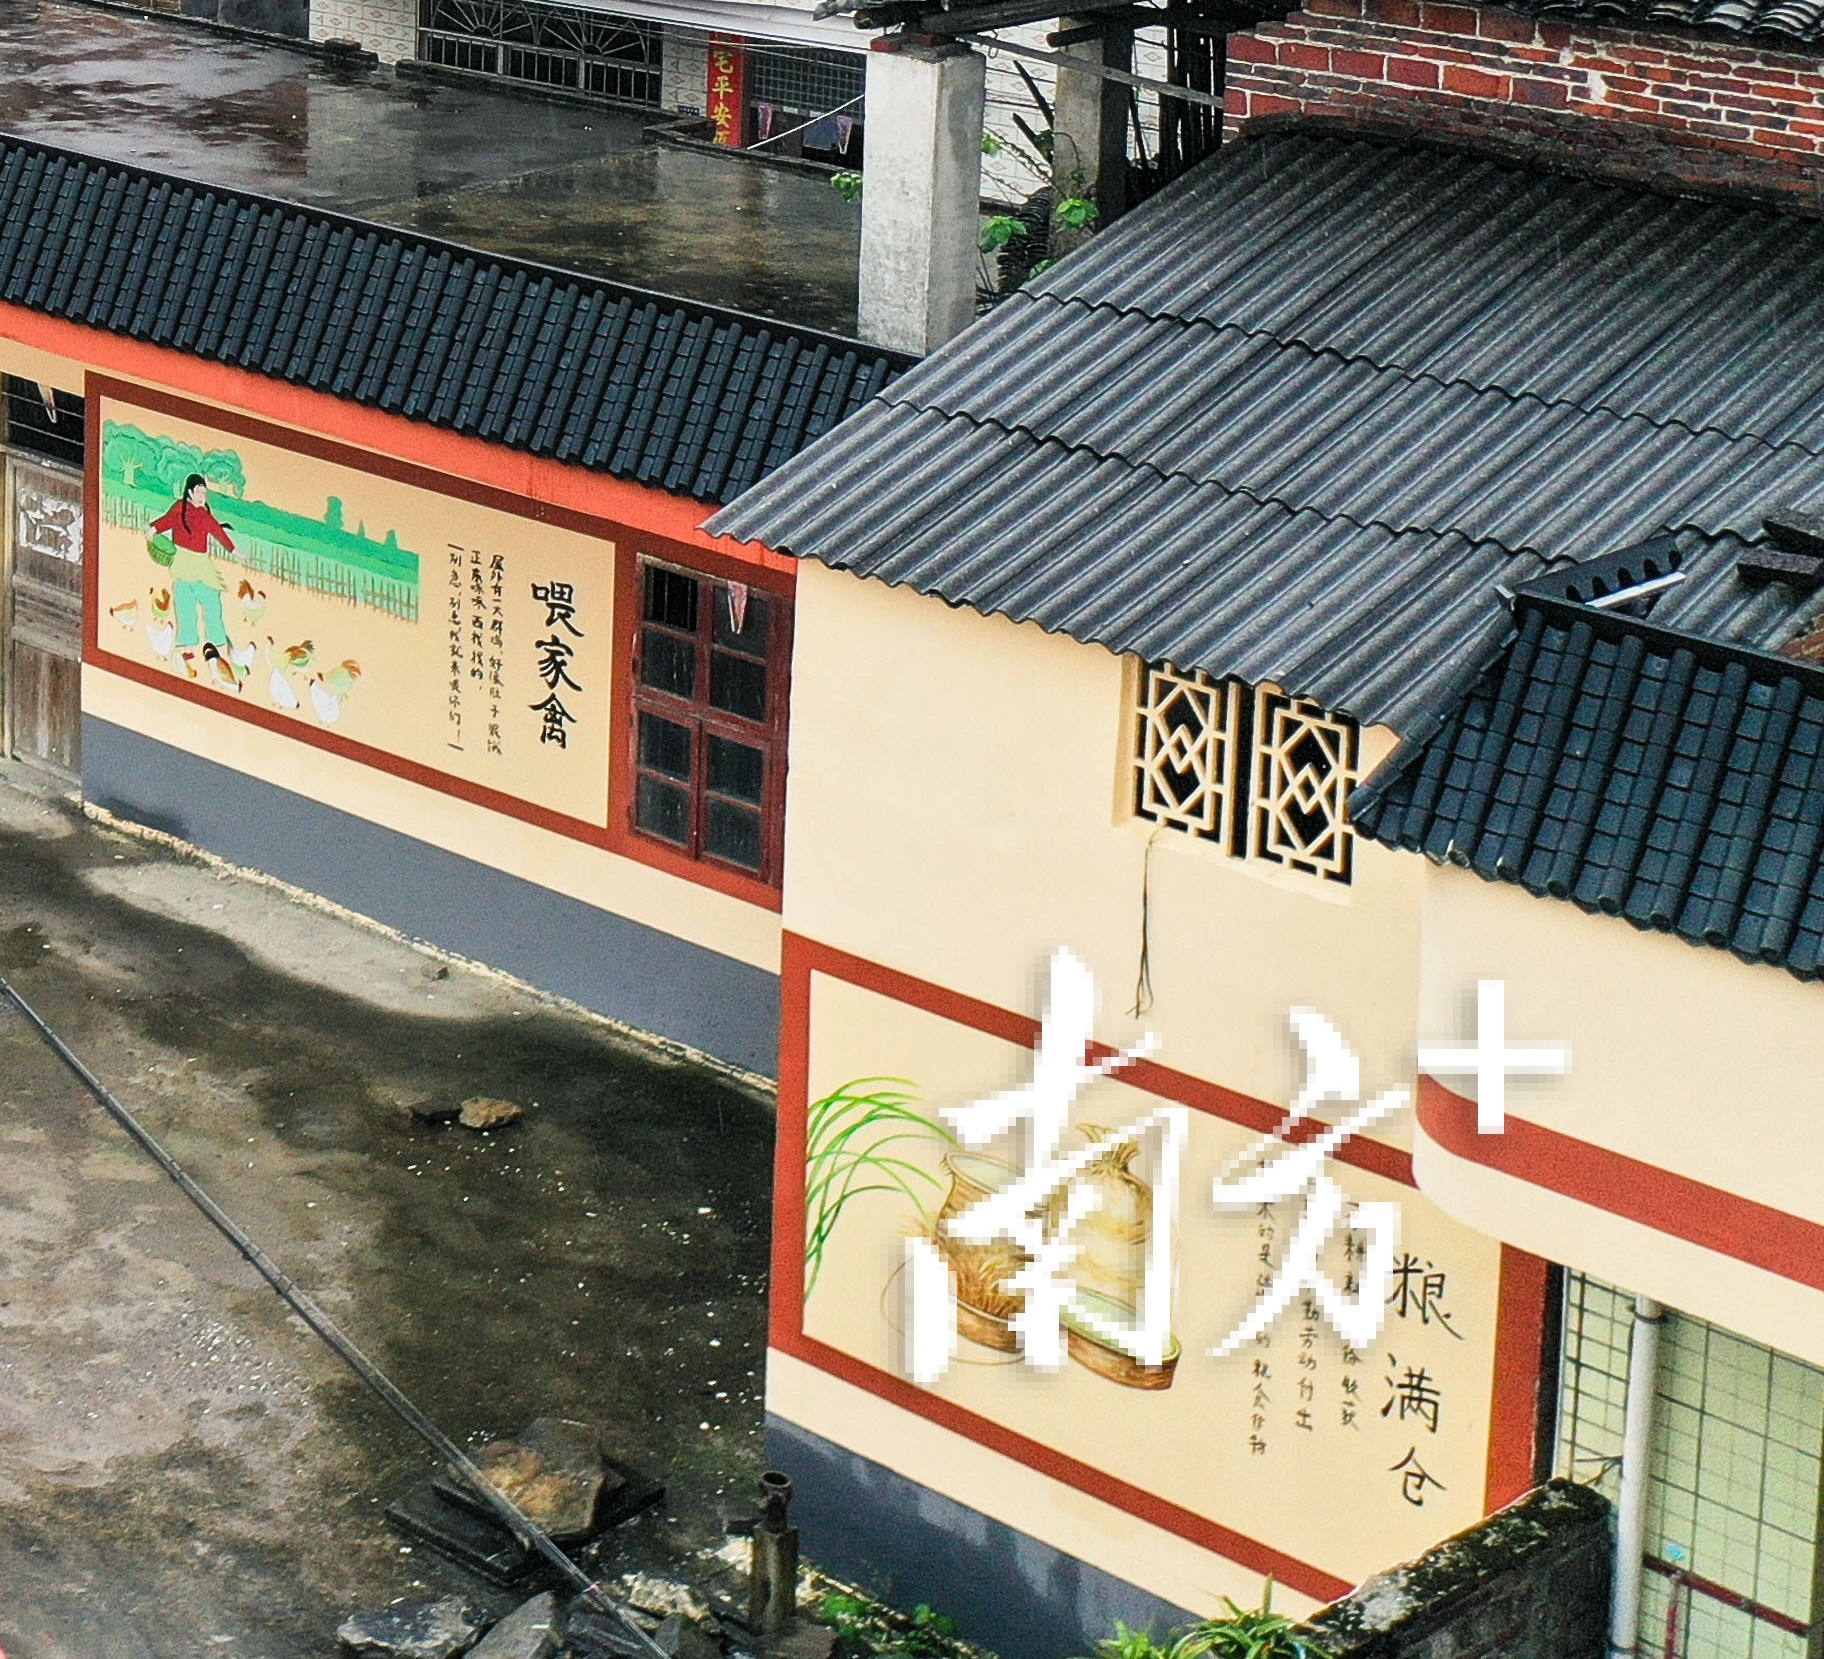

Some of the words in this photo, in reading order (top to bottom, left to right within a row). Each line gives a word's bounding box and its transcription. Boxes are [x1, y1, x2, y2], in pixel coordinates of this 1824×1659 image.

[528, 580, 585, 750] 喂家禽
[1381, 1251, 1466, 1507] 粮满仓
